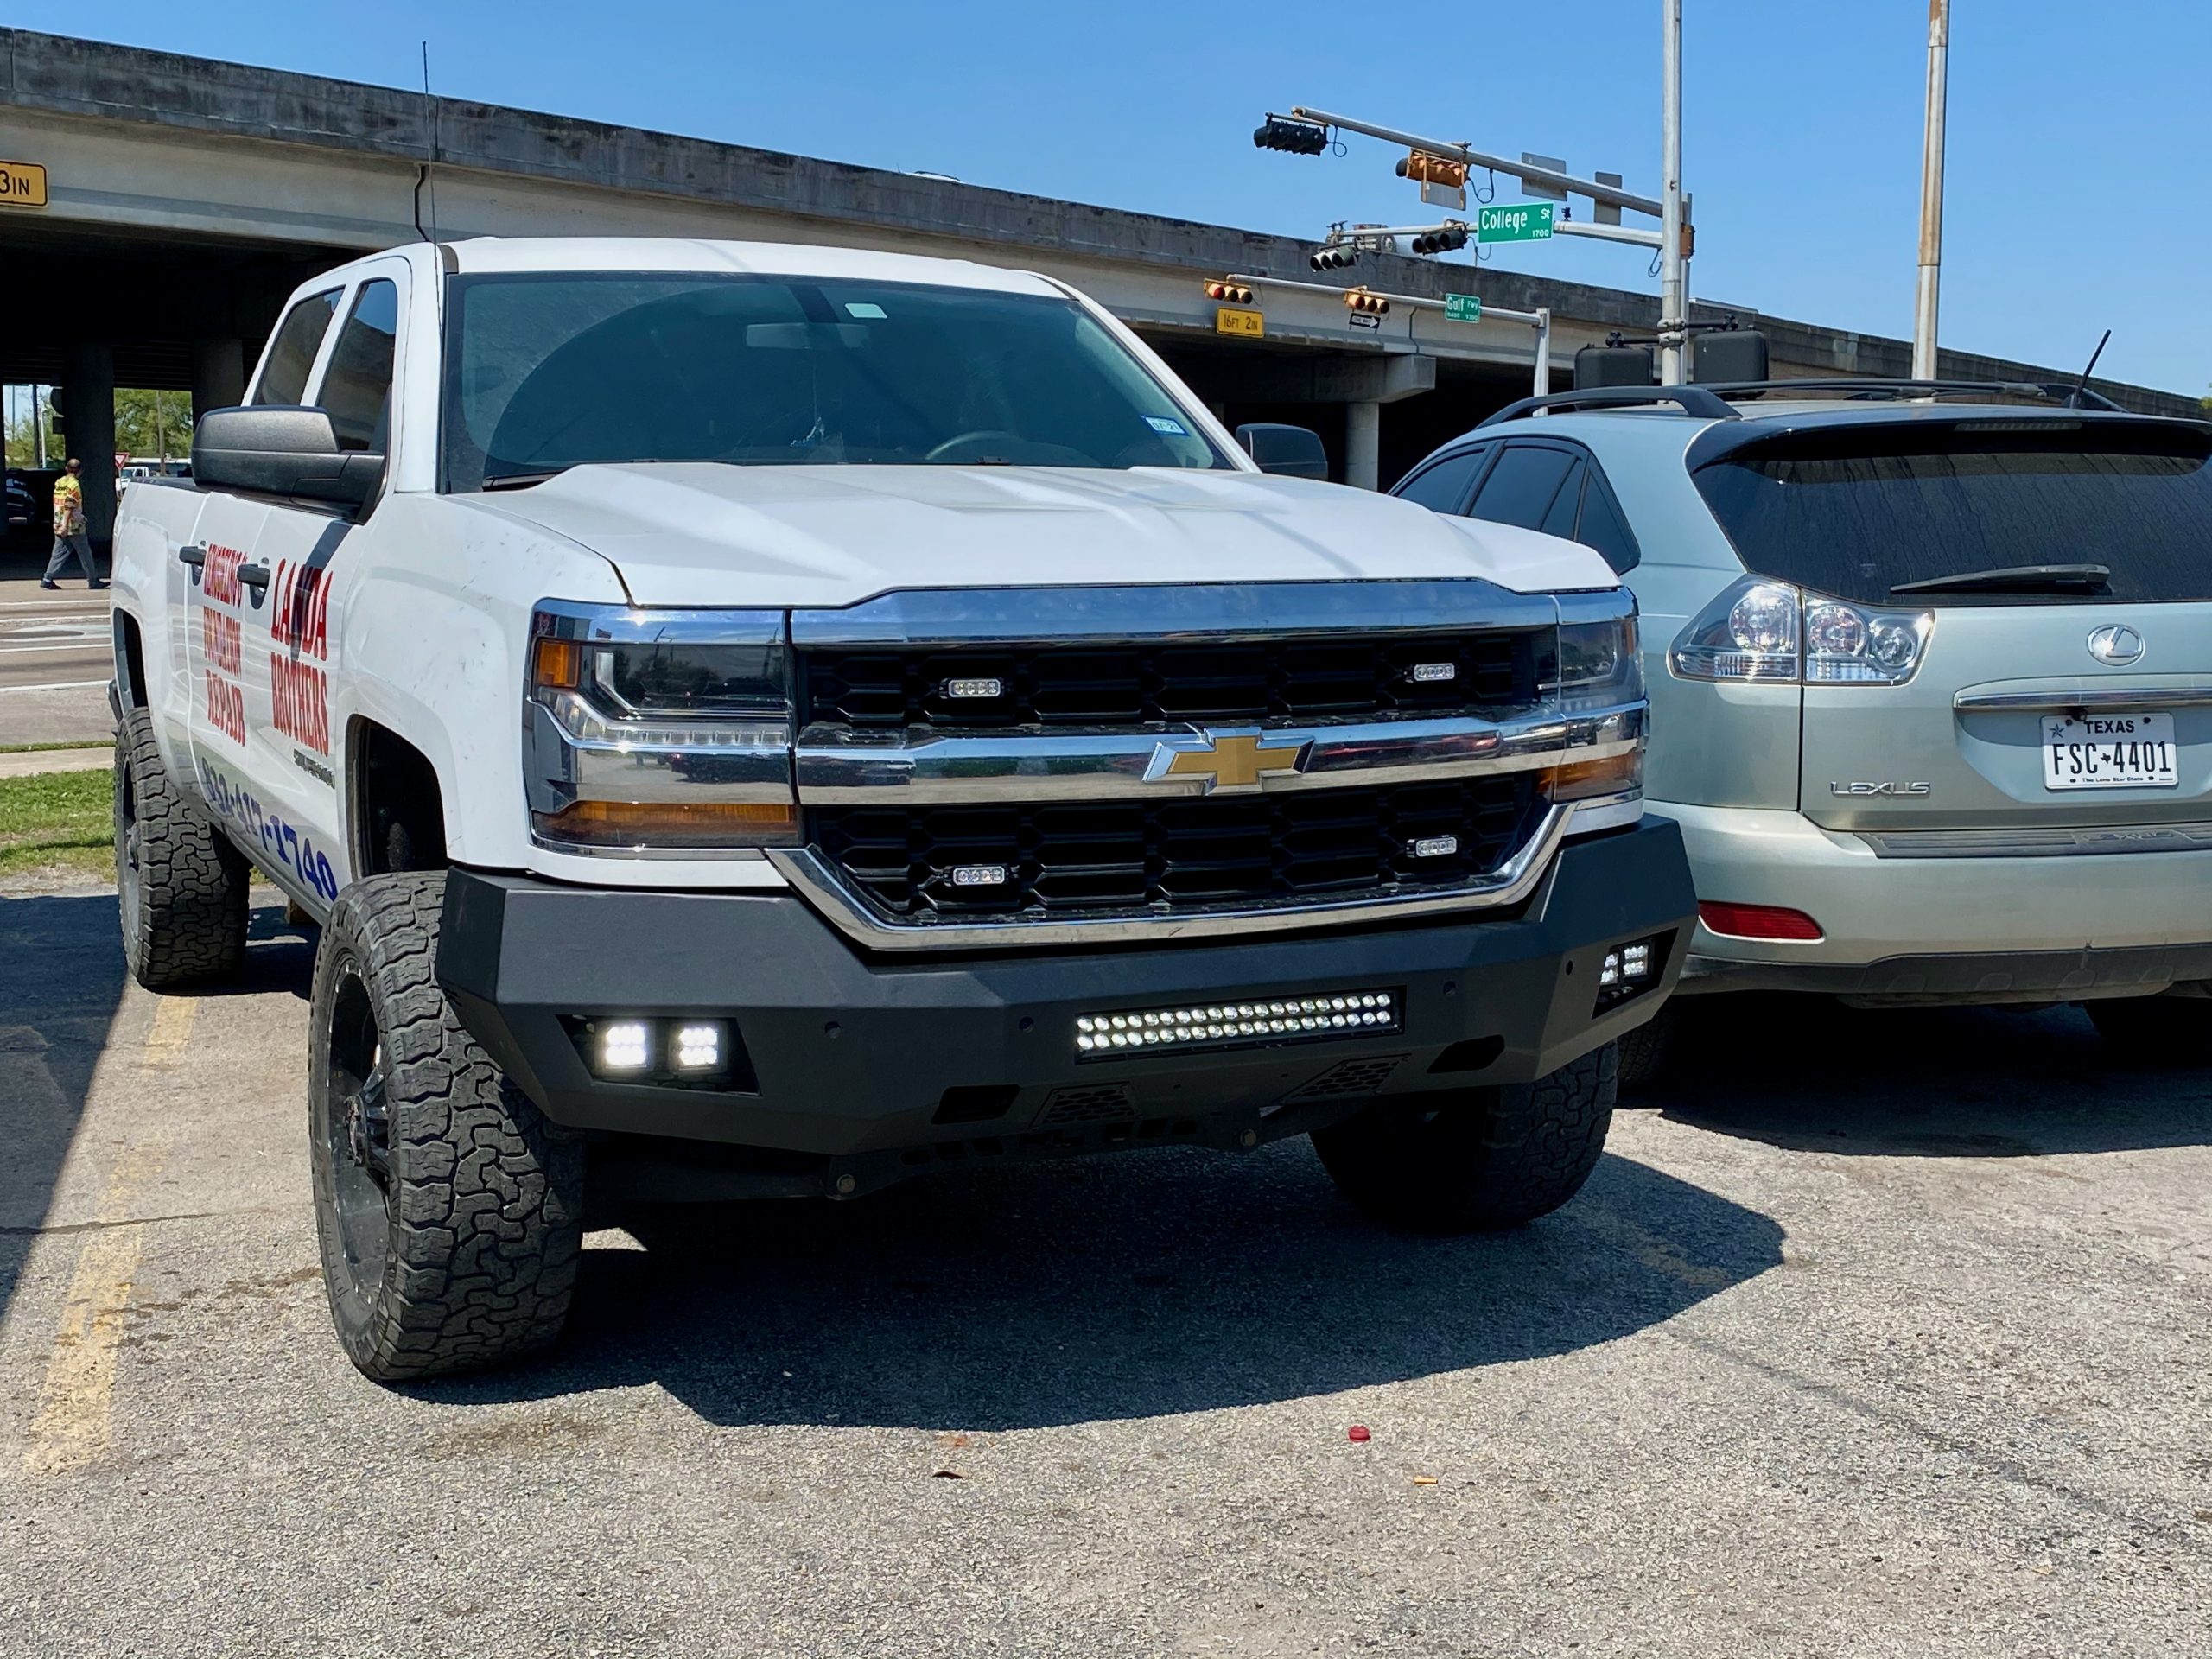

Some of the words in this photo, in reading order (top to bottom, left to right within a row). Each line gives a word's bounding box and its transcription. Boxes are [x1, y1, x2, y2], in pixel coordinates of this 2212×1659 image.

[0, 170, 29, 195] 3IN
[1481, 210, 1528, 234] College
[1541, 208, 1550, 219] St
[1532, 229, 1549, 238] 1700
[1447, 296, 1464, 311] Gulf
[1467, 300, 1478, 310] Fwy
[1224, 314, 1239, 329] 16FT
[1246, 316, 1258, 330] 2IN
[206, 668, 245, 747] REPAIR
[270, 651, 329, 758] BROTHERS
[2084, 720, 2135, 734] TEXAS
[2053, 742, 2098, 775] FSC
[2113, 741, 2171, 773] 4401
[1831, 781, 1930, 794] LEXUS
